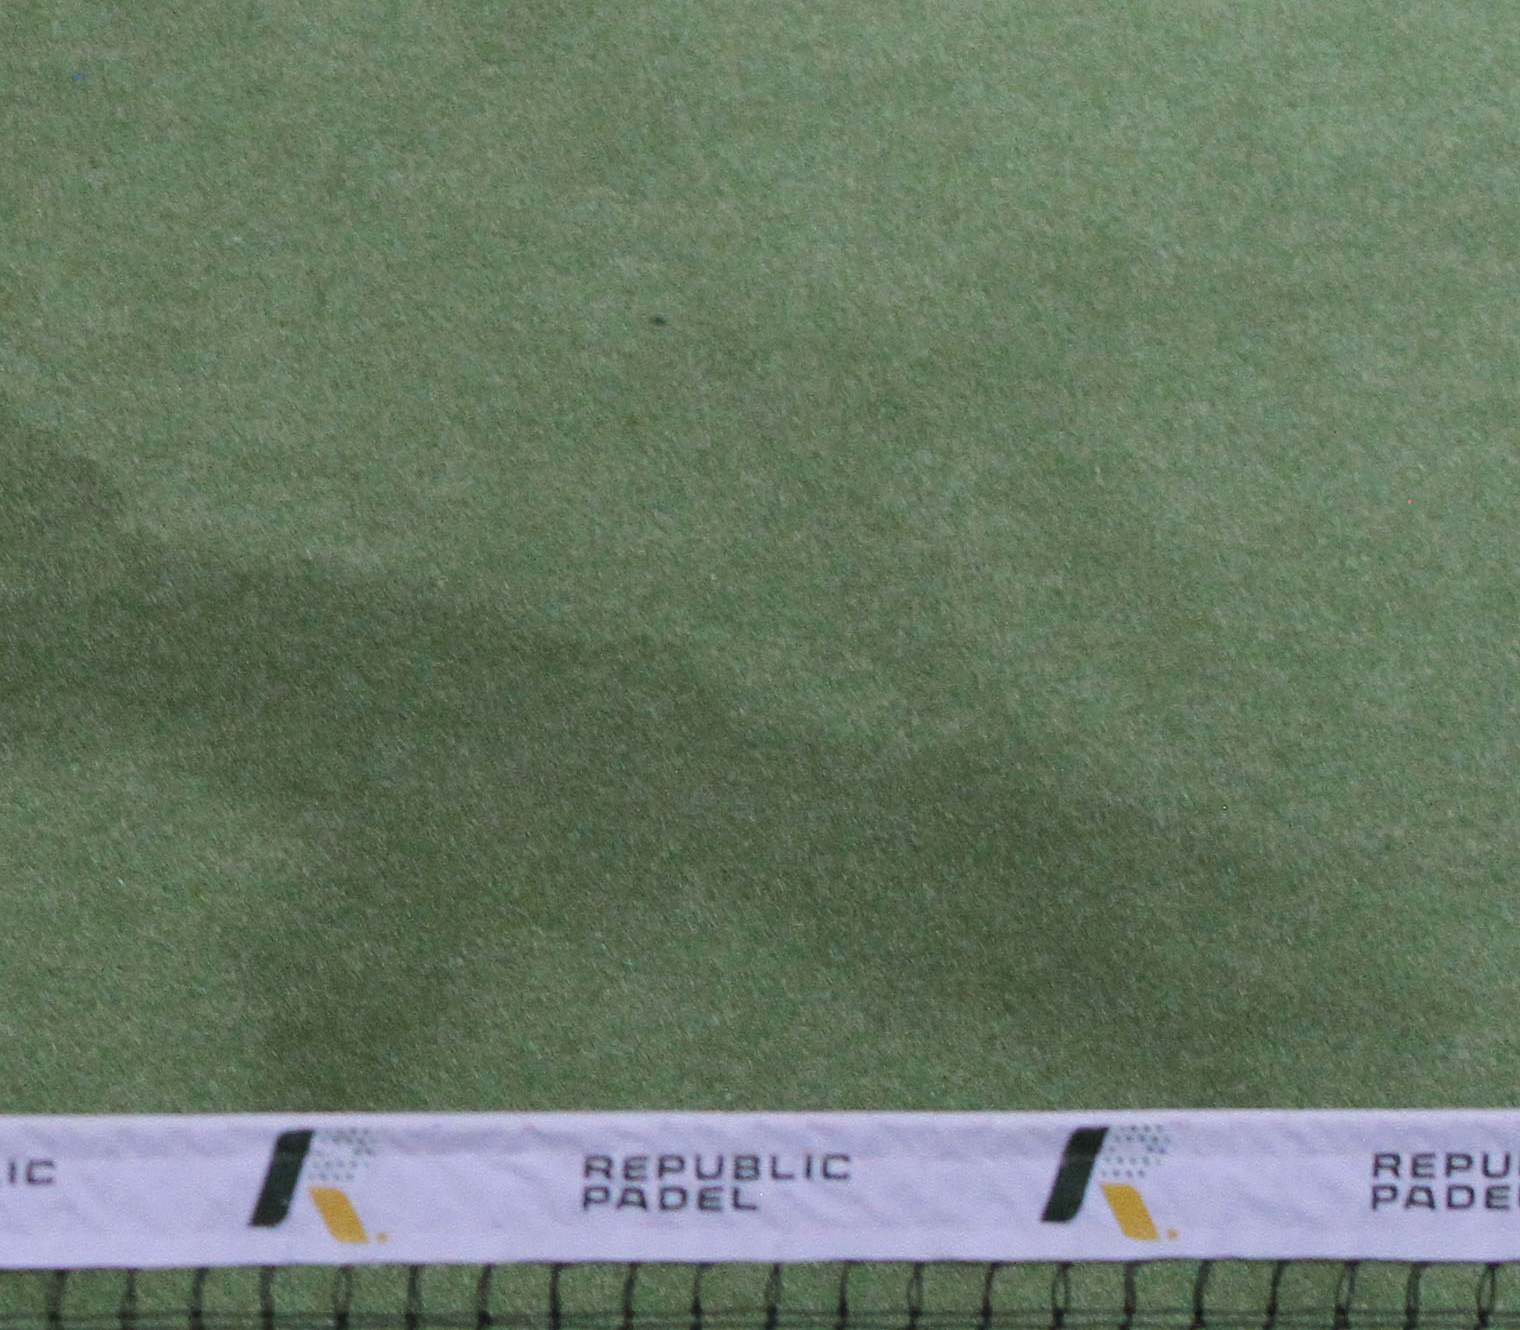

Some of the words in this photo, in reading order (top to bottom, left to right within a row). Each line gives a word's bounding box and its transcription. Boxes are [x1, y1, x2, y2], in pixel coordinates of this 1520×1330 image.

[583, 1154, 851, 1182] REPUBLIC
[1372, 1151, 1520, 1180] REPU
[581, 1185, 759, 1212] PADEL
[1370, 1184, 1520, 1211] PADE
